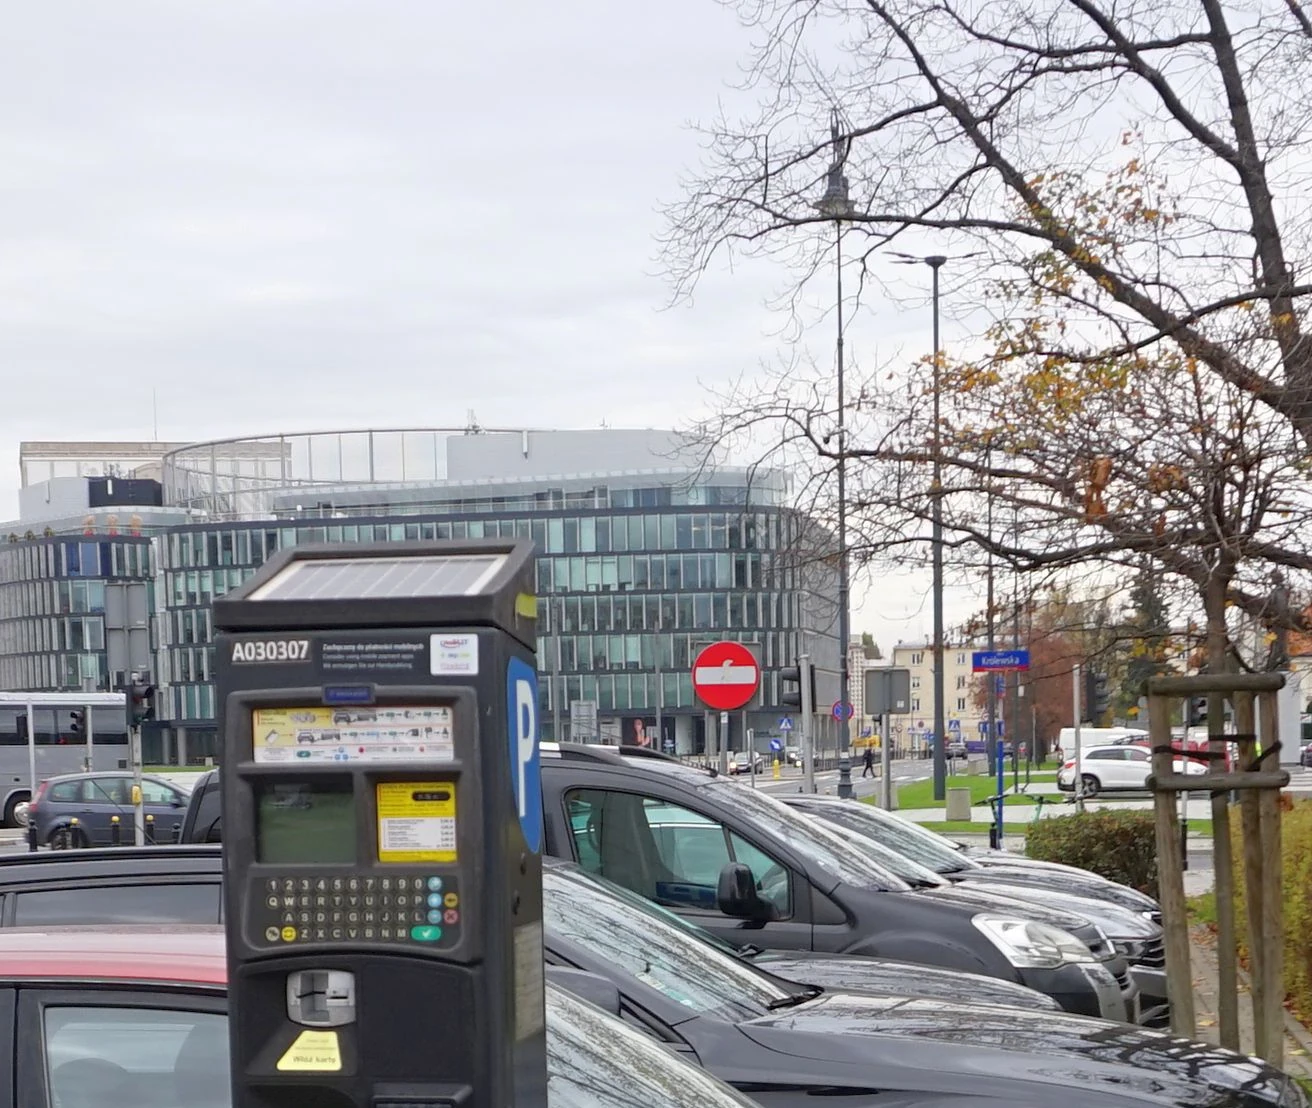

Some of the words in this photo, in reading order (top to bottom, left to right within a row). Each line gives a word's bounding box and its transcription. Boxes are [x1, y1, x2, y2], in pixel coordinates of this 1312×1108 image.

[231, 640, 310, 662] A030307
[980, 655, 1020, 666] Królewska
[516, 679, 535, 818] P
[286, 879, 293, 891] 2
[302, 879, 309, 890] 3
[317, 879, 325, 890] 4
[334, 879, 341, 890] 5
[350, 879, 357, 890] 6
[366, 879, 374, 889] 7
[398, 879, 406, 889] 9
[269, 897, 278, 907] Q
[284, 897, 295, 906] W
[301, 896, 308, 906] E
[317, 896, 325, 906] R
[334, 896, 341, 905] T
[350, 896, 357, 905] Y
[365, 896, 374, 906] U
[397, 896, 407, 905] O
[414, 895, 423, 905] P
[285, 913, 293, 922] A
[301, 912, 309, 922] S
[316, 912, 325, 922] D
[333, 912, 340, 922] F
[348, 912, 358, 922] G
[365, 913, 374, 921] H
[382, 912, 389, 922] J
[398, 912, 406, 921] K
[414, 912, 422, 922] L
[301, 929, 309, 938] Z
[317, 929, 324, 938] X
[332, 929, 341, 938] C
[349, 929, 357, 938] V
[365, 928, 373, 938] B
[381, 929, 390, 938] N
[397, 929, 406, 938] M
